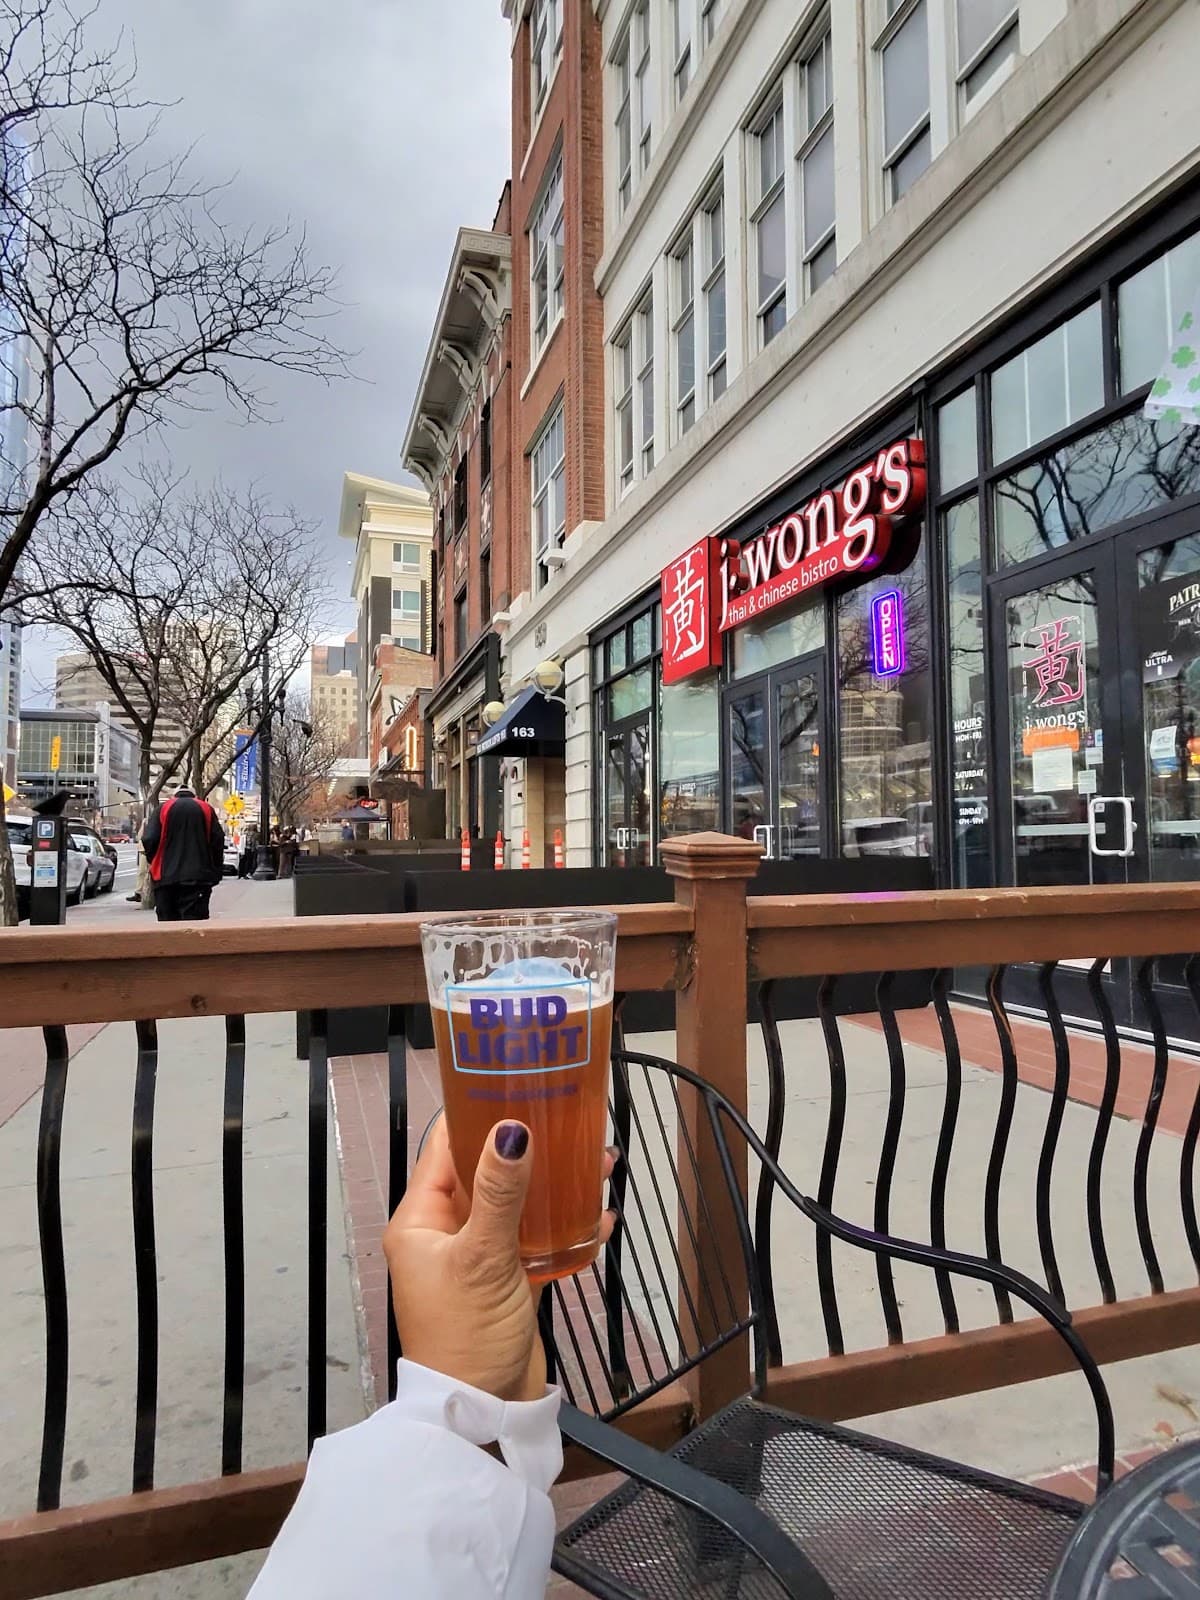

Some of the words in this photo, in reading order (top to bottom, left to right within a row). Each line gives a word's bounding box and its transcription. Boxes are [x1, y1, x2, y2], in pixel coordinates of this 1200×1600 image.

[728, 599, 748, 624] thai
[748, 595, 757, 614] &
[757, 577, 799, 610] chinese
[800, 556, 839, 587] bistro
[879, 599, 896, 668] OPEN
[1145, 655, 1173, 668] ULTRA
[954, 716, 982, 731] HOURS
[511, 727, 536, 738] 163
[955, 768, 984, 779] SATURDAY
[958, 806, 982, 816] SUNDAY
[470, 995, 568, 1030] BUD
[458, 1026, 583, 1064] LIGHT
